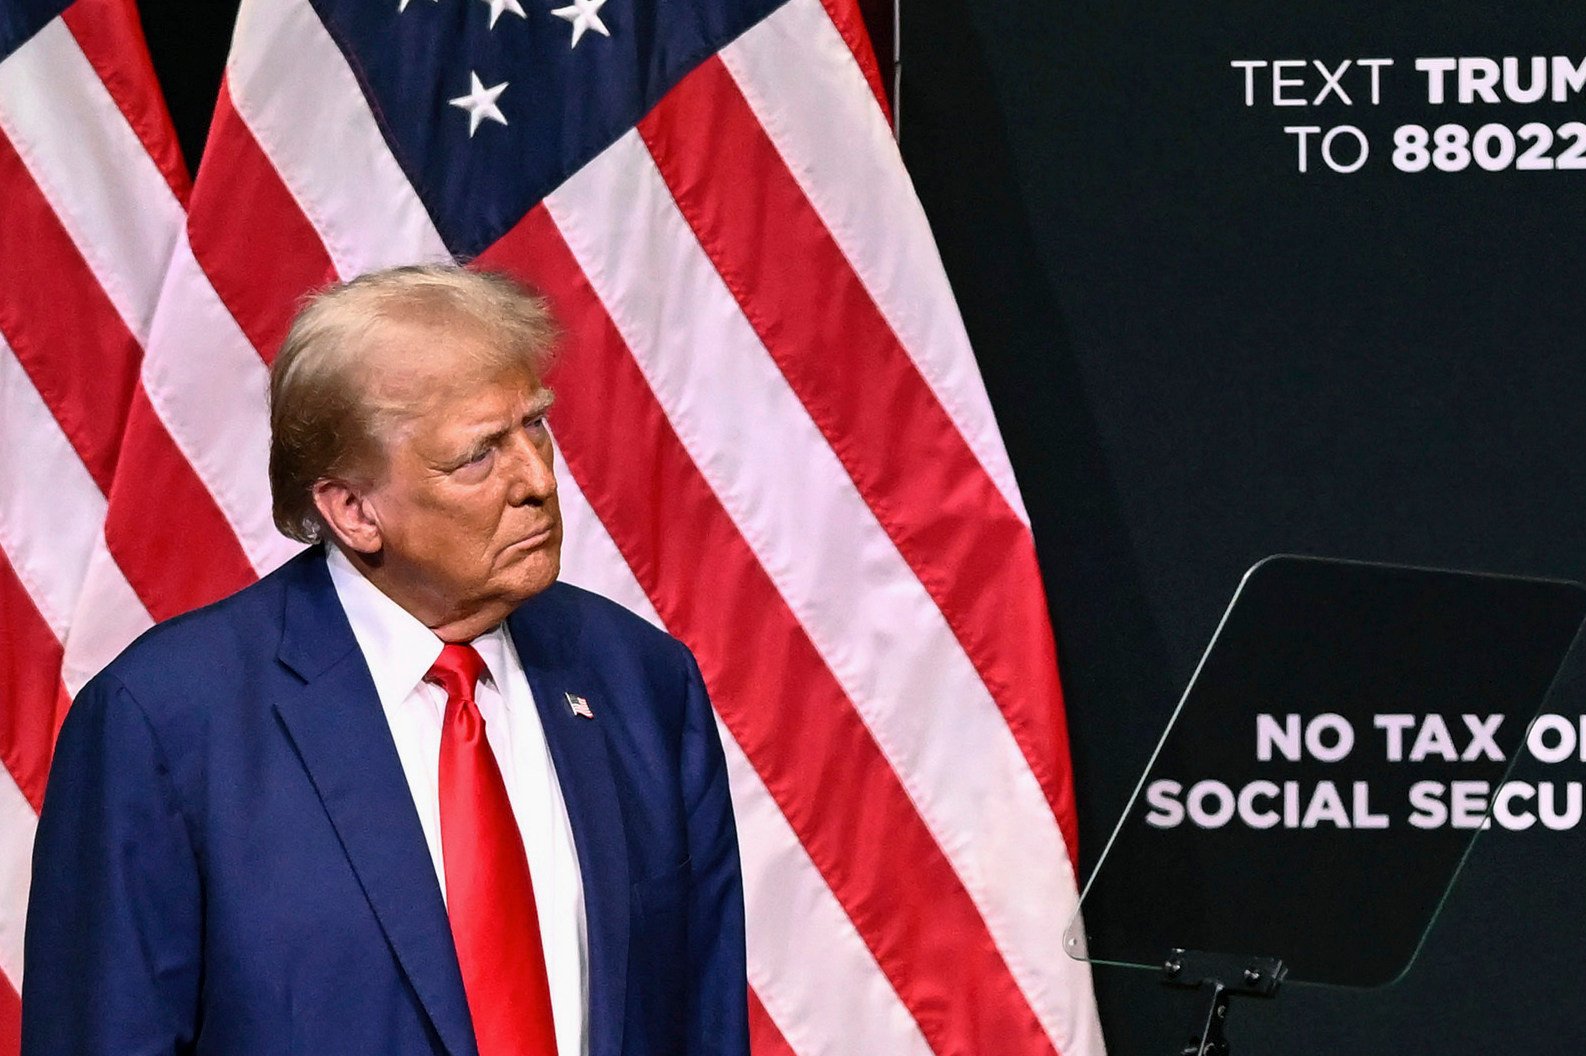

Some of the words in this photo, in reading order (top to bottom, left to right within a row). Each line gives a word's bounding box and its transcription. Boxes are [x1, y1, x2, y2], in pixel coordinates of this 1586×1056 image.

[1230, 58, 1395, 107] TEXT
[1283, 124, 1370, 174] TO
[1256, 713, 1355, 762] NO
[1373, 713, 1506, 762] TAX
[1146, 779, 1390, 829] SOCIAL
